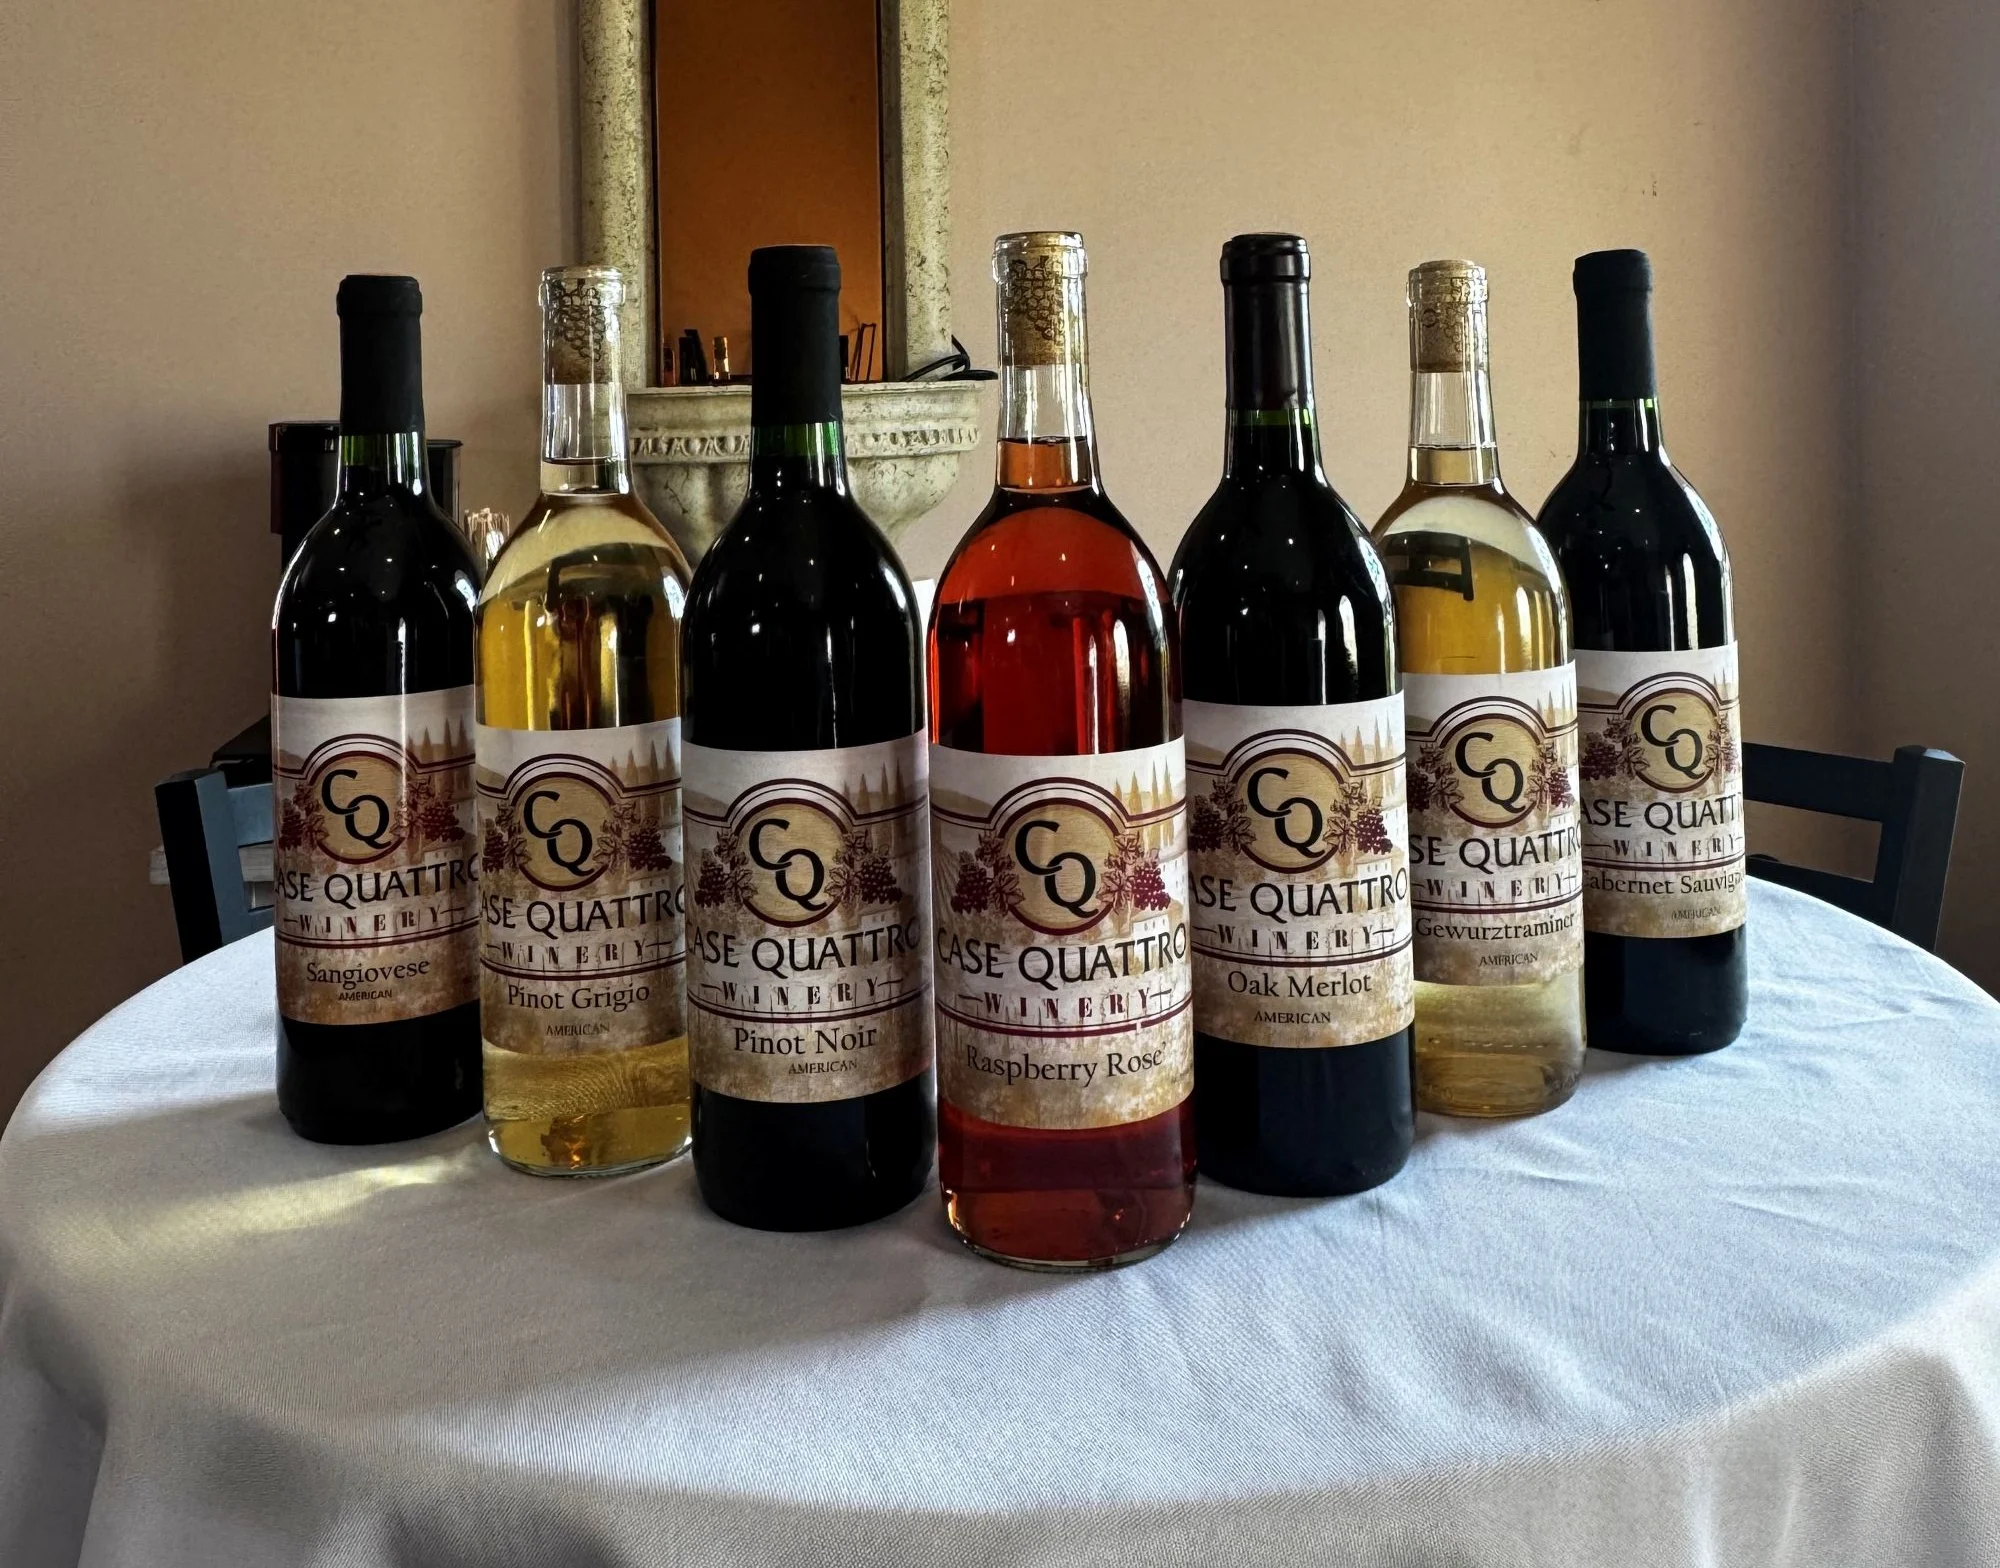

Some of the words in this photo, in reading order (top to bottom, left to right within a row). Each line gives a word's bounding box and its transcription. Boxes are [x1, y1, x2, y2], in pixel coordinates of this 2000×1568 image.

[1580, 796, 1632, 828] ASE
[1408, 834, 1446, 866] SE
[1613, 833, 1736, 858] WINERY
[276, 867, 313, 902] ASE
[1189, 870, 1237, 912] ASE
[1250, 867, 1408, 924] QUATTRO
[1426, 872, 1565, 899] WINERY
[299, 907, 440, 933] WINERY
[480, 890, 516, 929] ASE
[1217, 925, 1374, 950] WINERY
[1415, 911, 1575, 941] Gewurztraminer
[501, 939, 646, 964] WINERY
[751, 916, 920, 979] QUATTRO
[936, 926, 1004, 979] CASE
[1018, 923, 1187, 991] QUATTRO
[1478, 953, 1539, 967] AMERICAN
[306, 959, 431, 990] Sangiovese
[1228, 970, 1280, 998] Oak
[1287, 972, 1372, 999] Merlot
[339, 989, 392, 1001] AMERICAN
[508, 985, 564, 1010] Pinot
[571, 984, 650, 1013] Grigio
[722, 976, 878, 1006] WINERY
[982, 988, 1151, 1019] WINERY
[546, 1022, 610, 1037] AMERICAN
[1254, 1011, 1331, 1025] AMERICAN
[734, 1027, 806, 1055] Pinot
[815, 1025, 877, 1053] Noir
[788, 1059, 858, 1075] AMERICAN
[966, 1044, 1098, 1088] Raspberry
